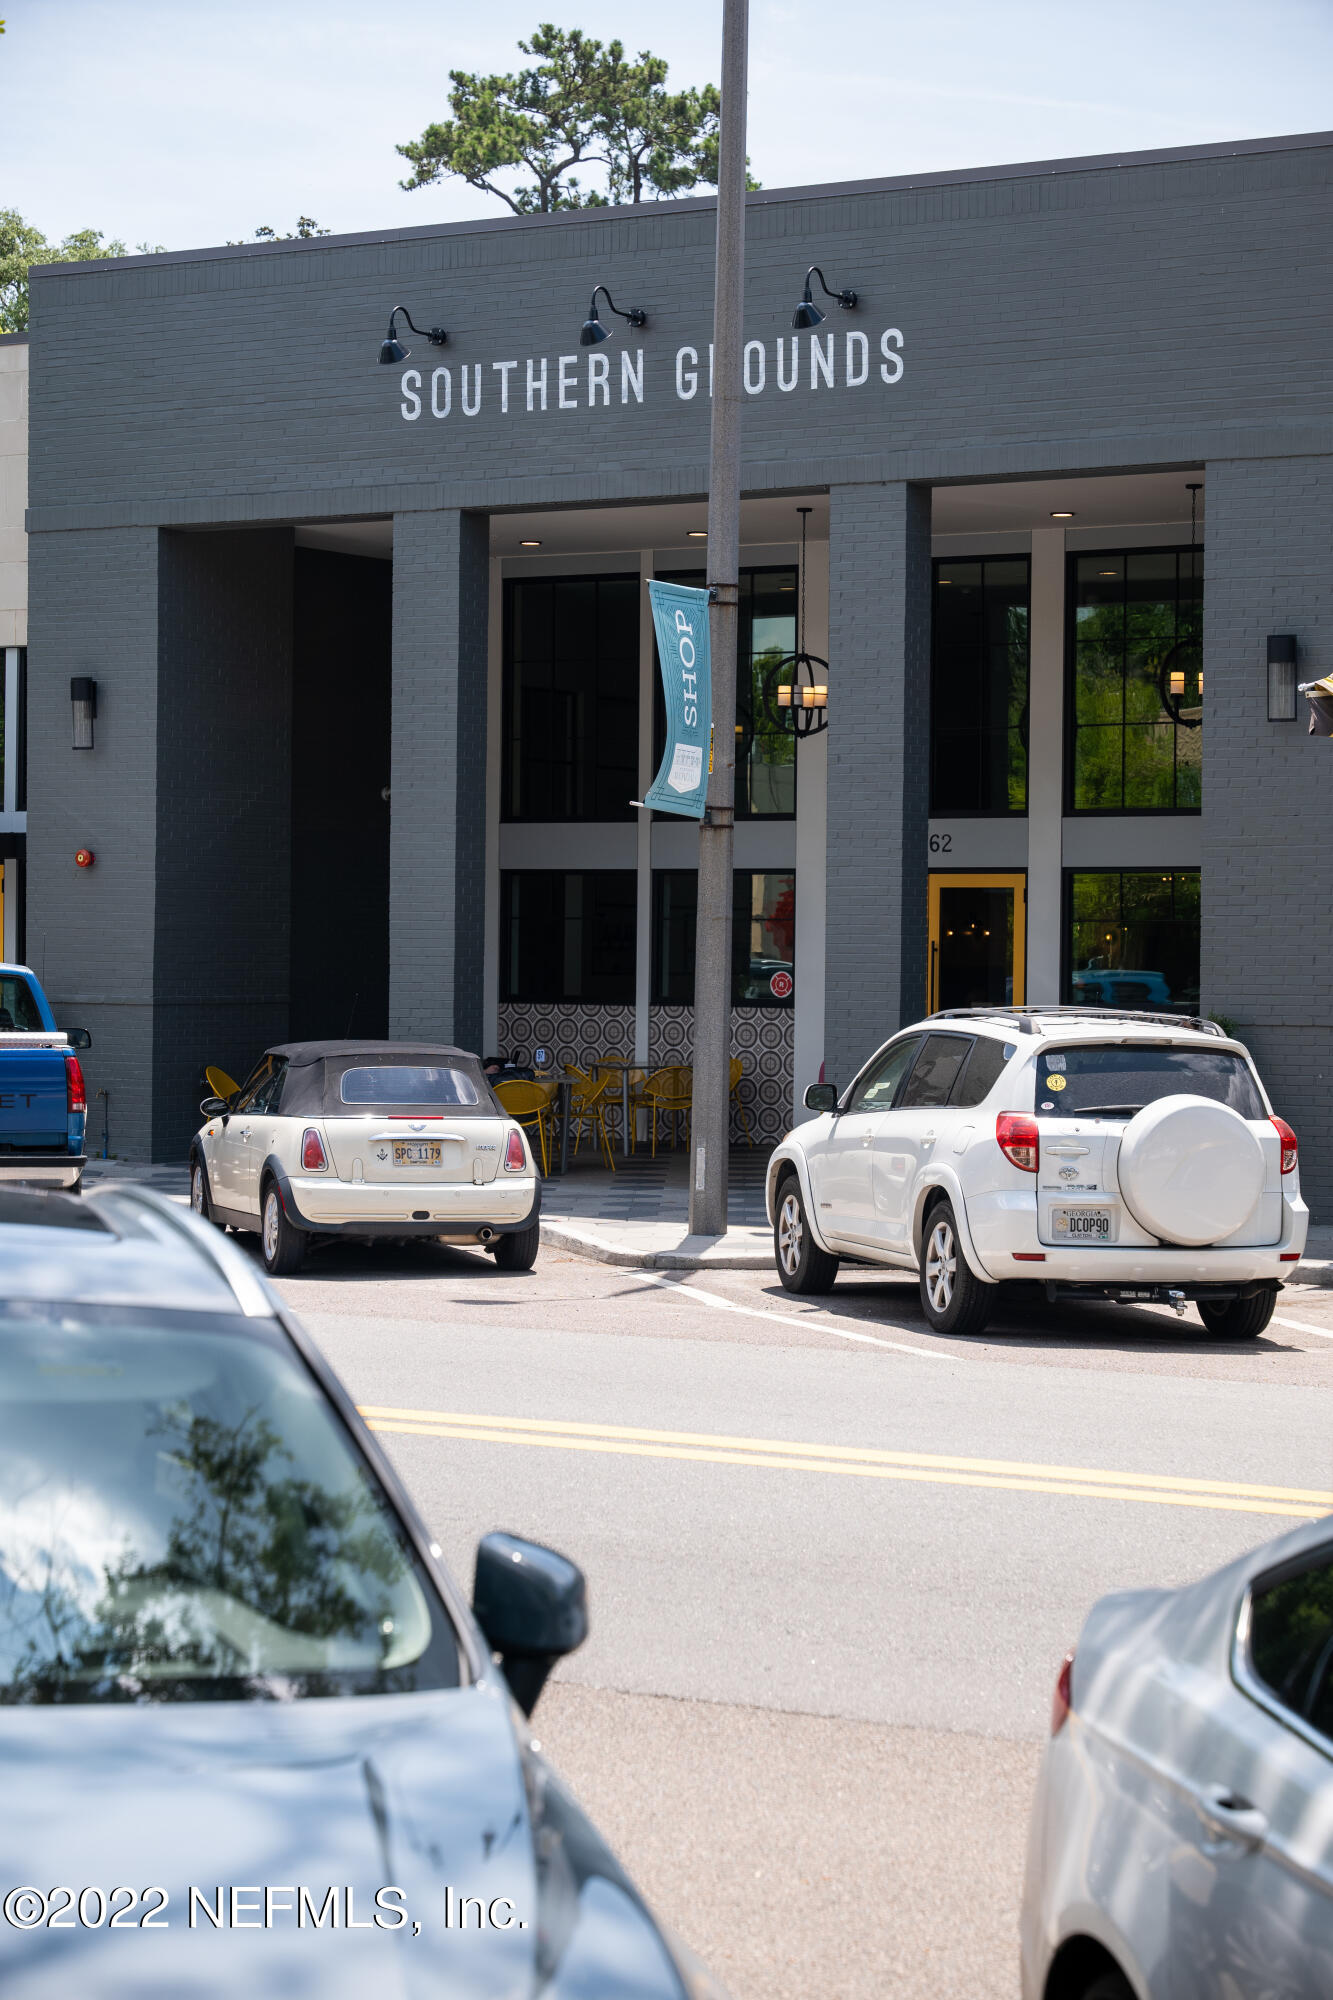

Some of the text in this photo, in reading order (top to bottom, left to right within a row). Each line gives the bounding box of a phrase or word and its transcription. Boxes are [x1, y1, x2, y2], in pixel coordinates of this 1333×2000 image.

[400, 328, 904, 421] SOUTHERN GOUNDS
[674, 609, 698, 728] SHOP
[929, 833, 952, 853] 62
[395, 1147, 441, 1160] SPC 1179
